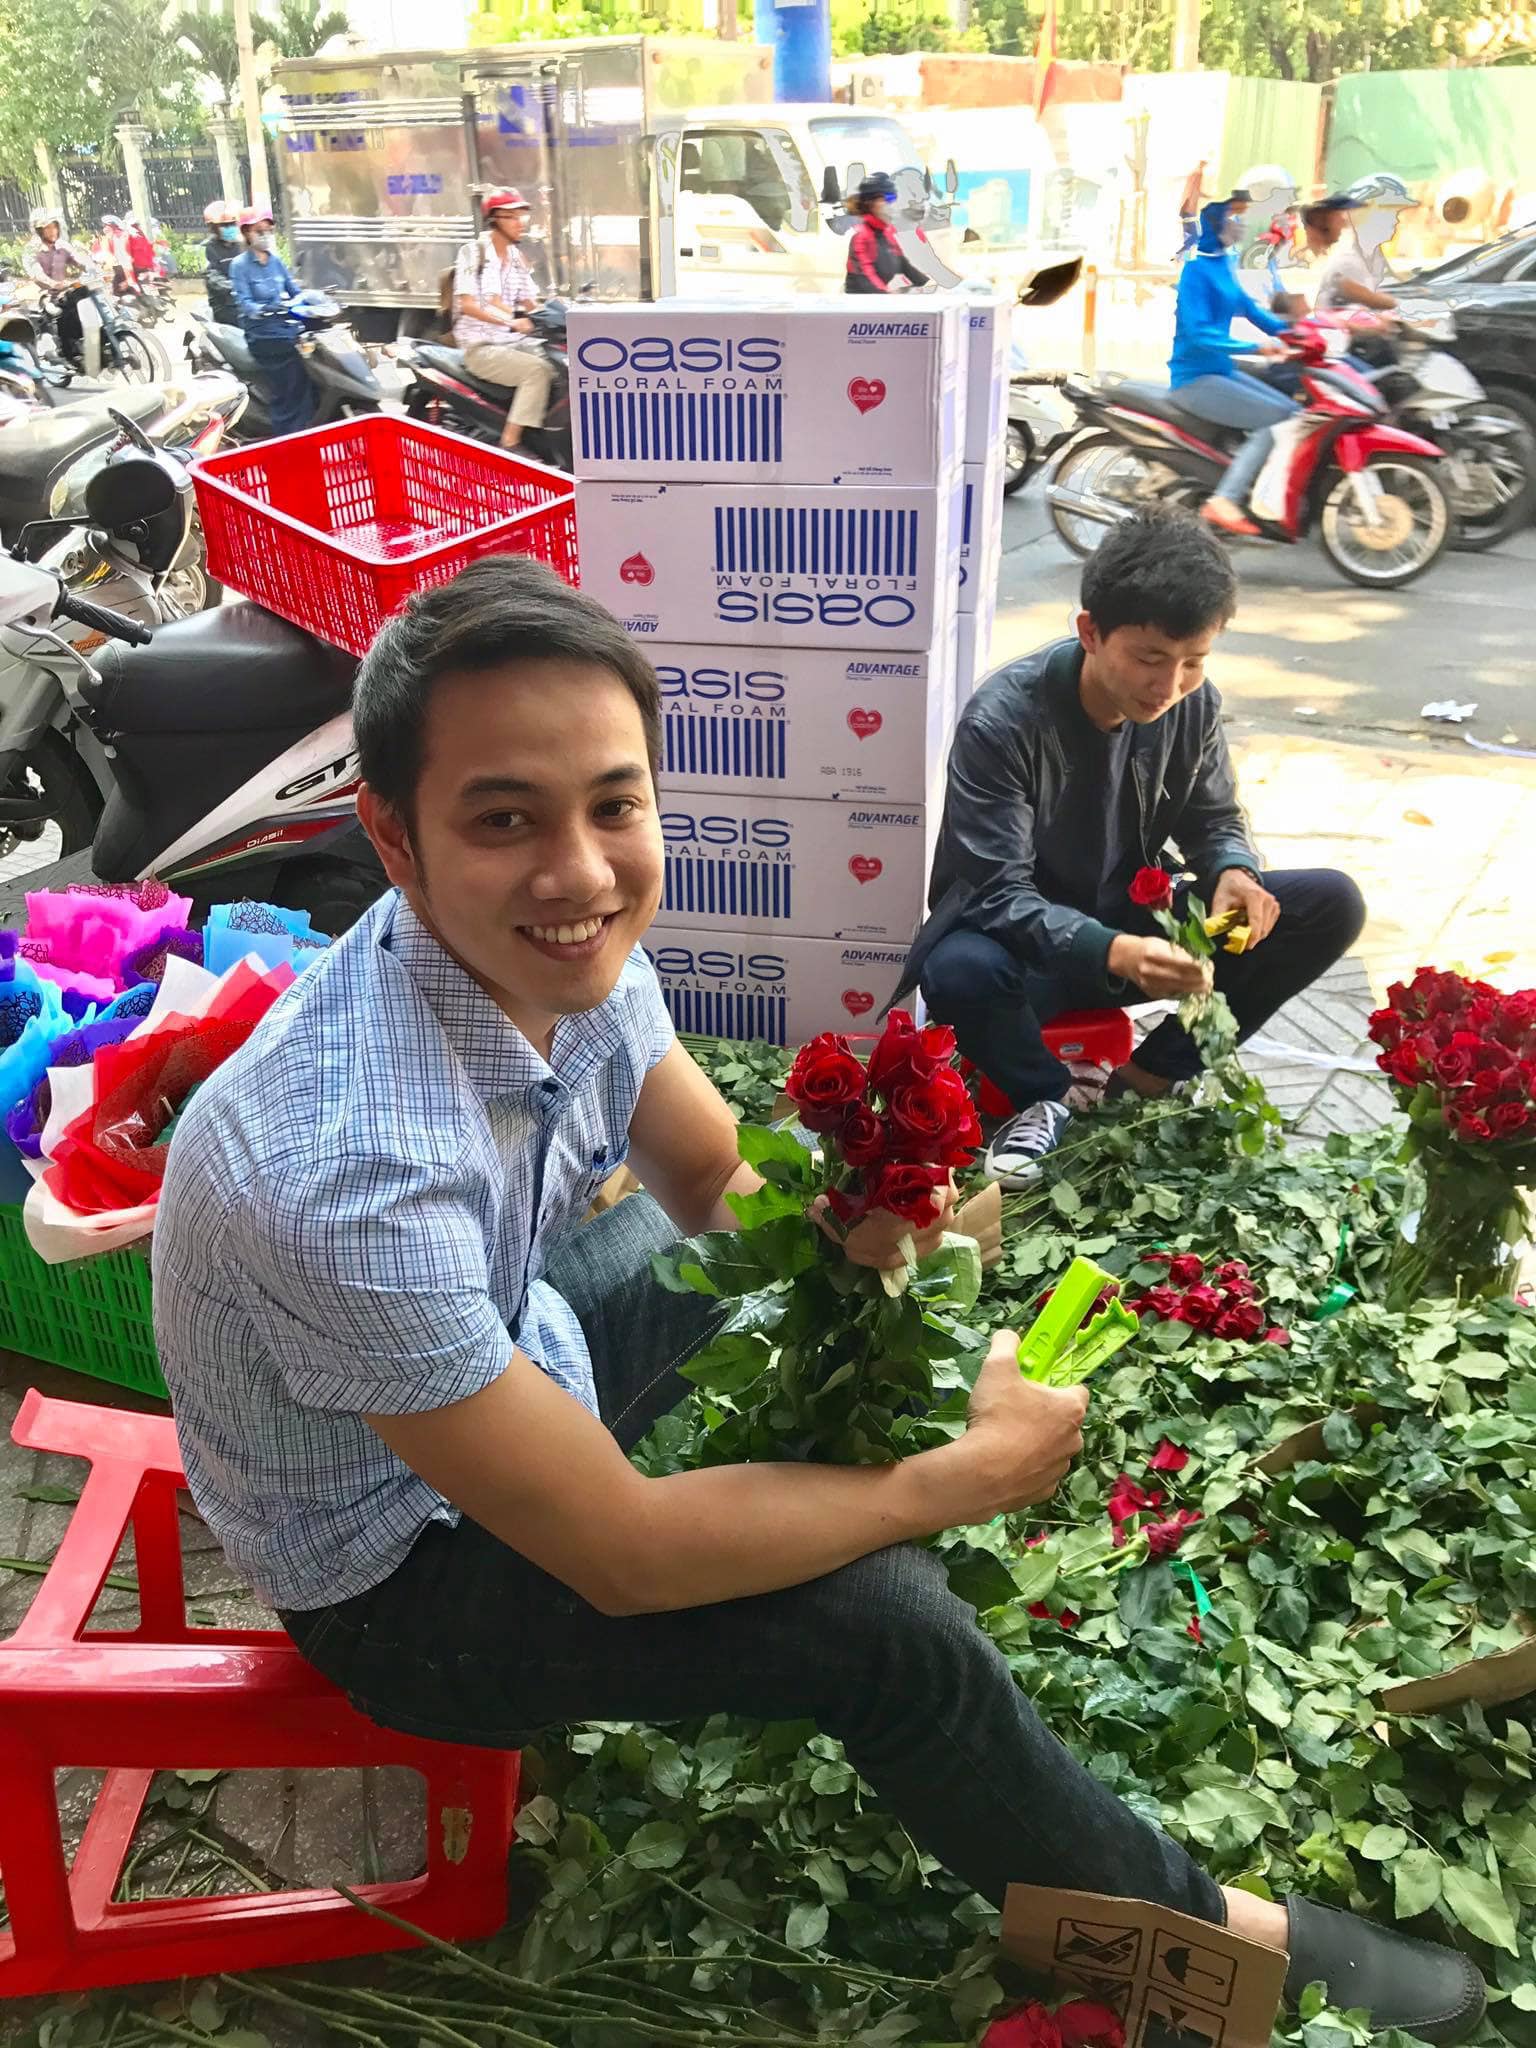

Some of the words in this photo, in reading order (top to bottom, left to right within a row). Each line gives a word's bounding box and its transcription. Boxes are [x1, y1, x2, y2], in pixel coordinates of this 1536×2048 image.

[848, 323, 929, 336] ADVANTAGE
[578, 377, 688, 390] FLORAL
[703, 378, 783, 390] FOAM
[716, 575, 791, 588] FOAM
[805, 577, 917, 591] FLORAL
[846, 662, 920, 676] ADVANTAGE
[713, 704, 786, 717] FOAM
[848, 812, 920, 825] ADVANTAGE
[721, 848, 791, 862] FOAM
[718, 981, 786, 995] FOAM
